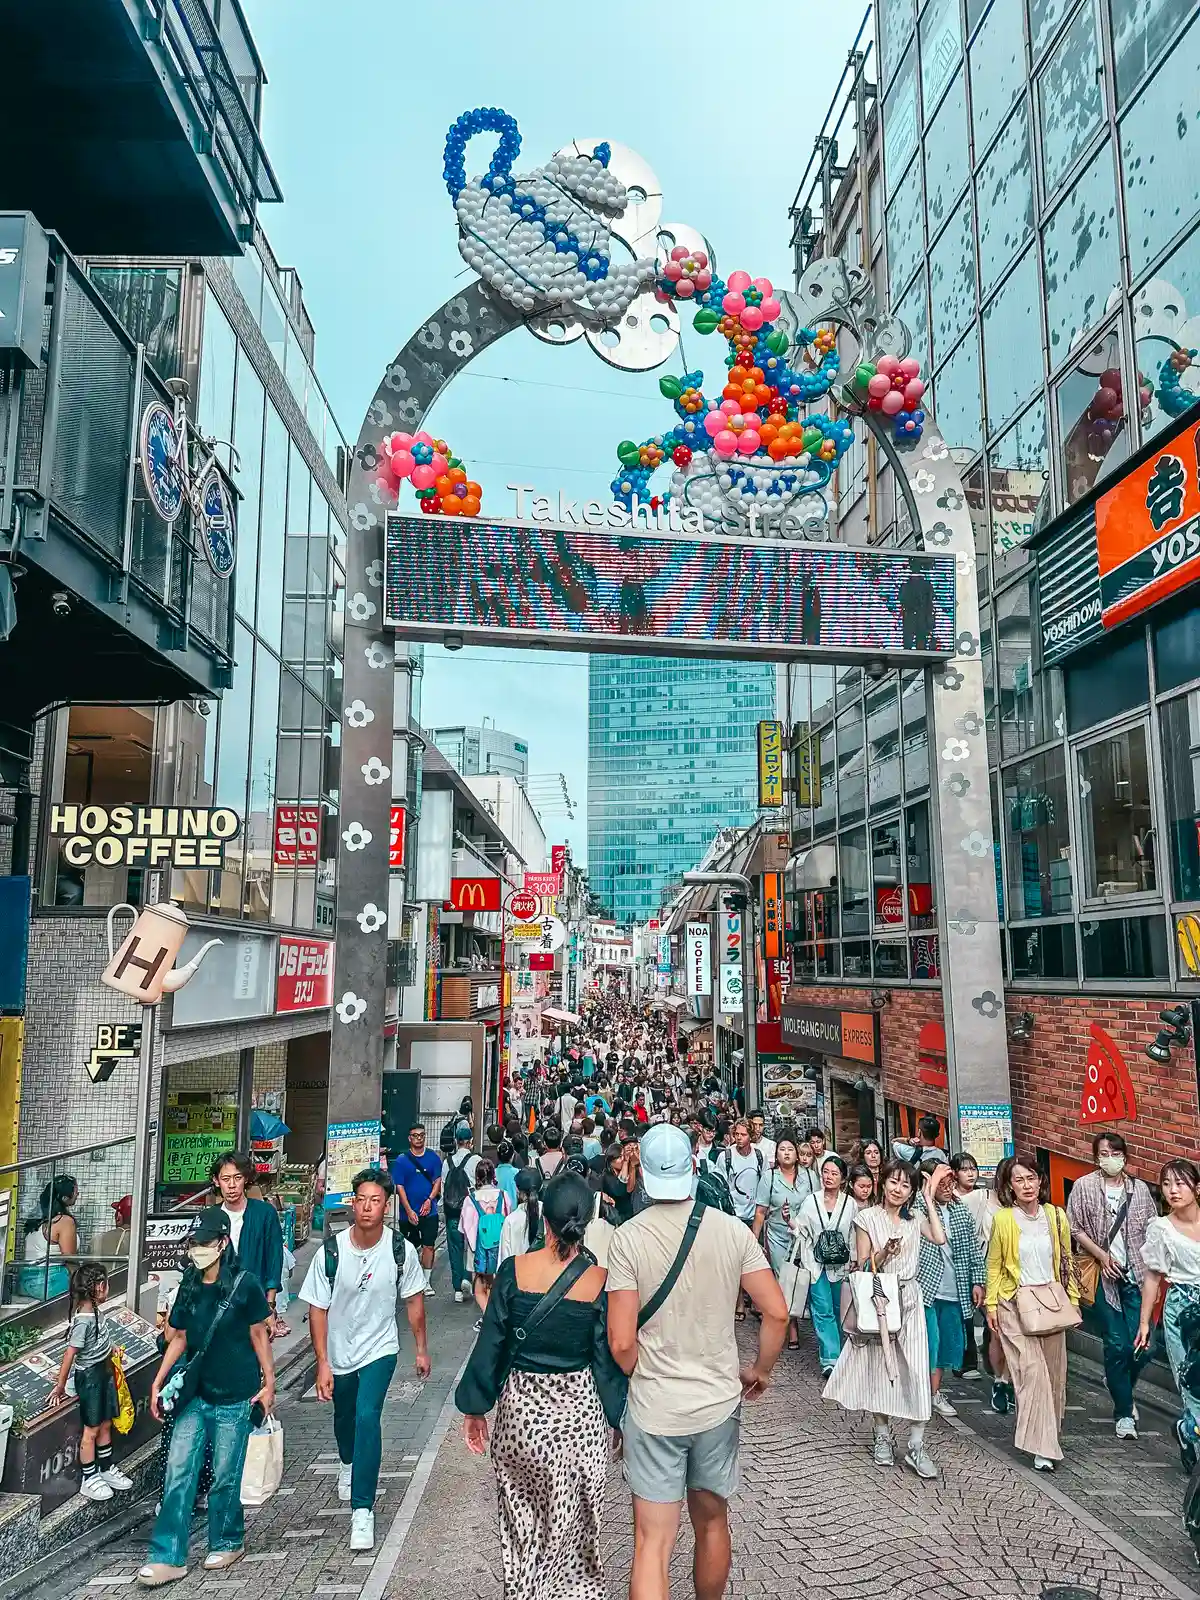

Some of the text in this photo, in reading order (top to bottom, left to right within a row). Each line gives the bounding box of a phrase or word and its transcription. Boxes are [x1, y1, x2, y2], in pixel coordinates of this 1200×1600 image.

[507, 484, 842, 543] Takeshita Street
[1043, 599, 1101, 645] YOSHINOYA
[764, 723, 780, 796] コインロッカー
[51, 805, 237, 837] HOSHINO
[65, 836, 222, 866] COFFEE
[512, 900, 535, 911] 消火栓
[540, 916, 555, 949] 古着
[688, 927, 709, 936] NOA
[112, 936, 168, 991] H
[695, 940, 703, 992] COFFEE
[293, 980, 315, 1004] クスリ
[98, 1025, 128, 1050] BF
[843, 1027, 873, 1047] EXPRESS
